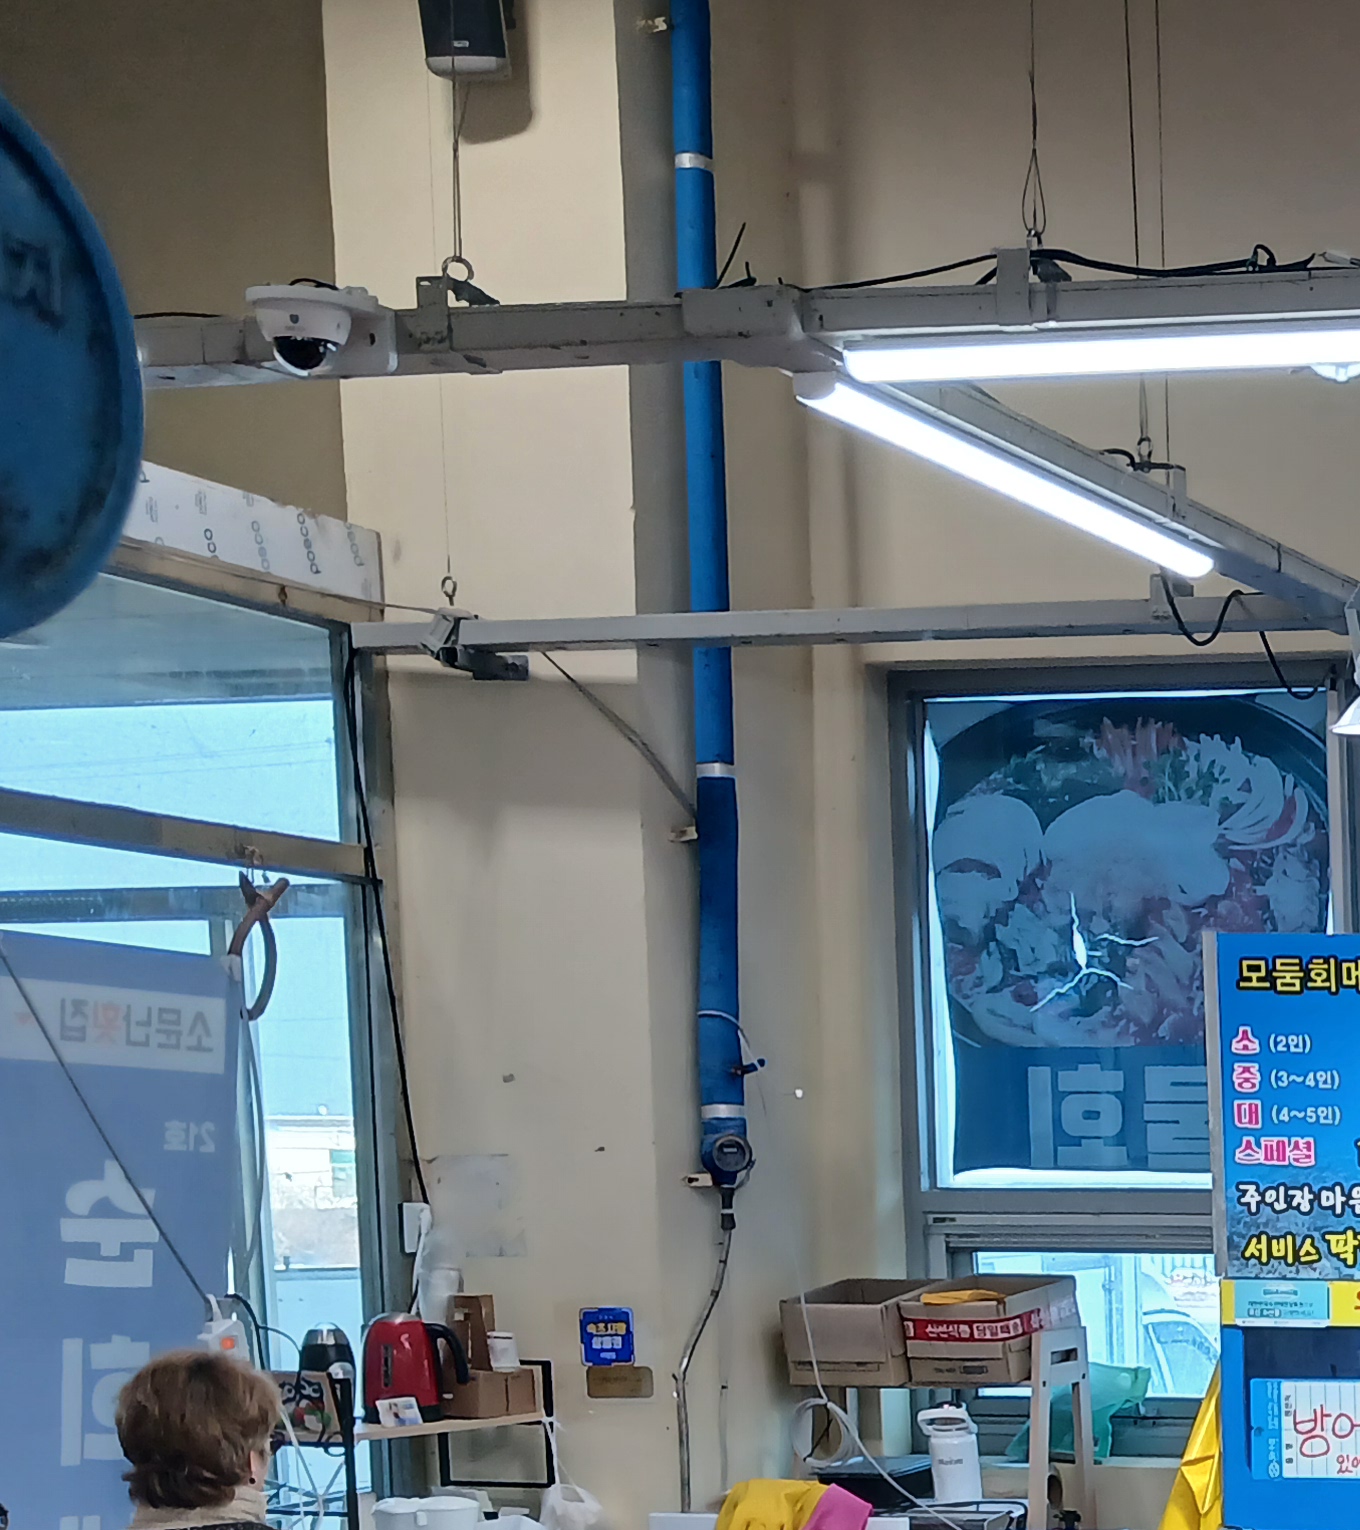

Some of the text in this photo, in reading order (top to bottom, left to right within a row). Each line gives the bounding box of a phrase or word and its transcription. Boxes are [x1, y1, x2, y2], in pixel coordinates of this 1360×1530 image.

[1231, 1025, 1260, 1054] 소
[1269, 1033, 1311, 1053] (2인)
[1232, 1063, 1261, 1093] 중
[1270, 1069, 1340, 1089] (3~4인)
[1233, 1100, 1262, 1129] 대
[1271, 1104, 1342, 1126] (4~5인)
[1235, 1136, 1316, 1167] 스페셜
[1237, 1182, 1315, 1216] 주인장
[1244, 1231, 1320, 1265] 서비스
